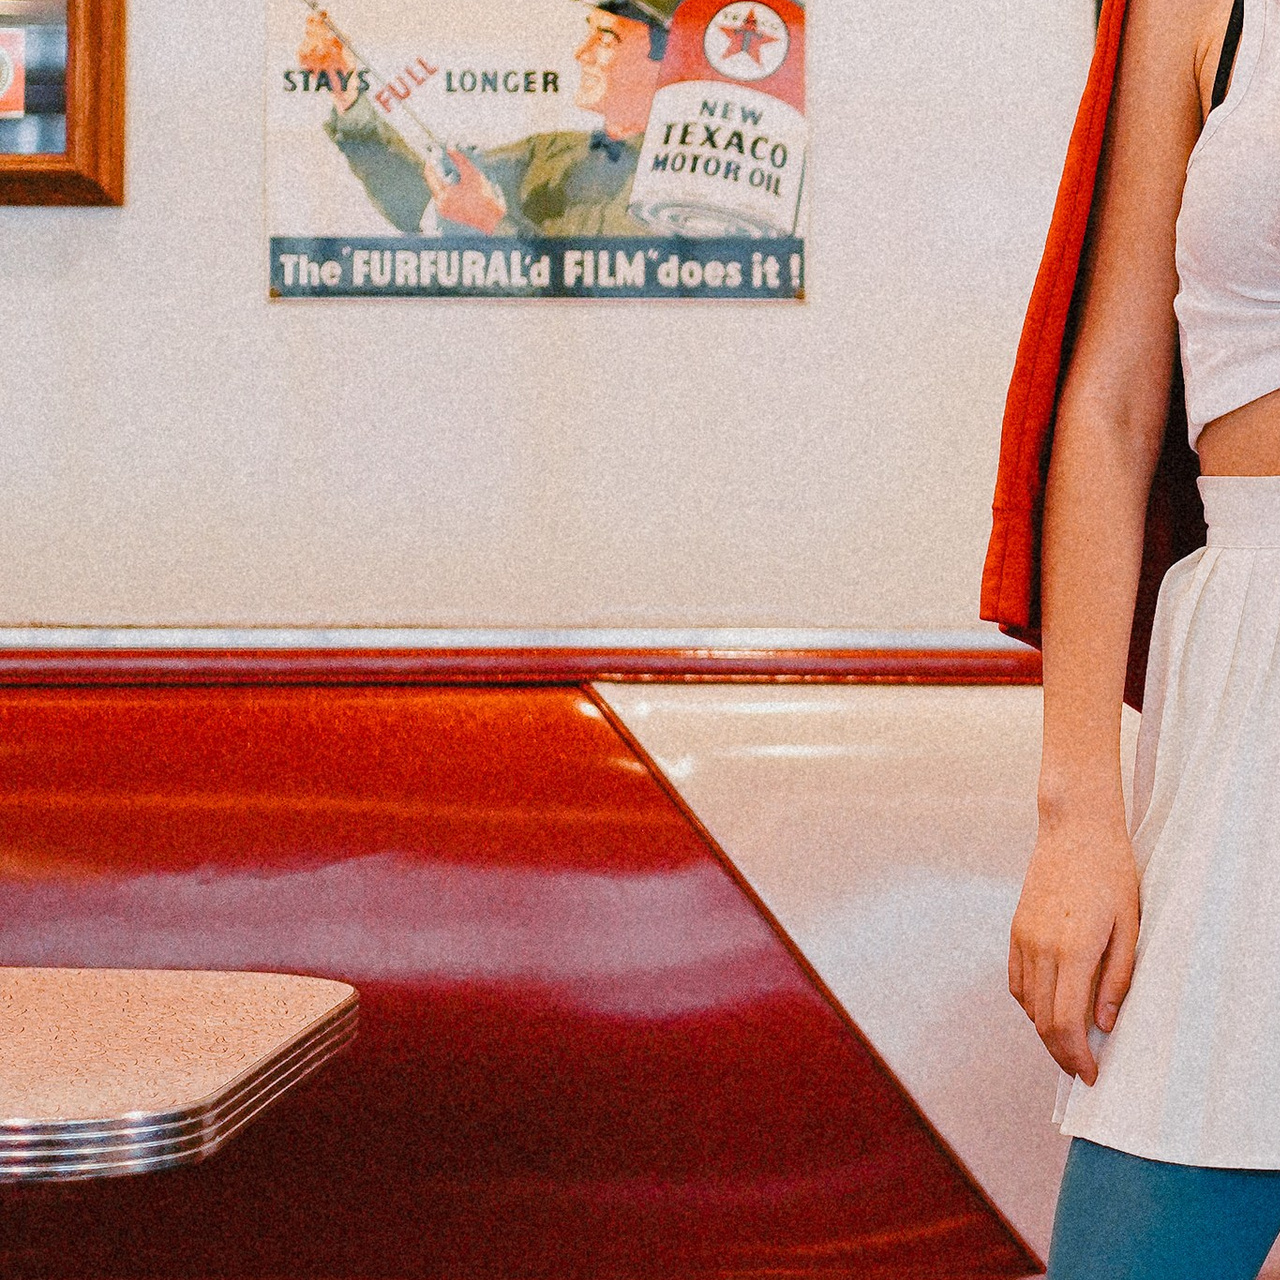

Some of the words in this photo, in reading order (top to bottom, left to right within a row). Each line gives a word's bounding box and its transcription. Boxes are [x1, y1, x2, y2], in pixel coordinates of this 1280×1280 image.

[283, 69, 371, 92] STAYS
[374, 56, 439, 113] FULL
[445, 70, 560, 93] LONGER
[701, 98, 763, 126] NEW
[664, 122, 788, 169] TEXACO
[652, 152, 741, 182] MOTOR
[750, 168, 782, 199] OIL
[280, 253, 342, 286] The
[657, 254, 742, 288] does
